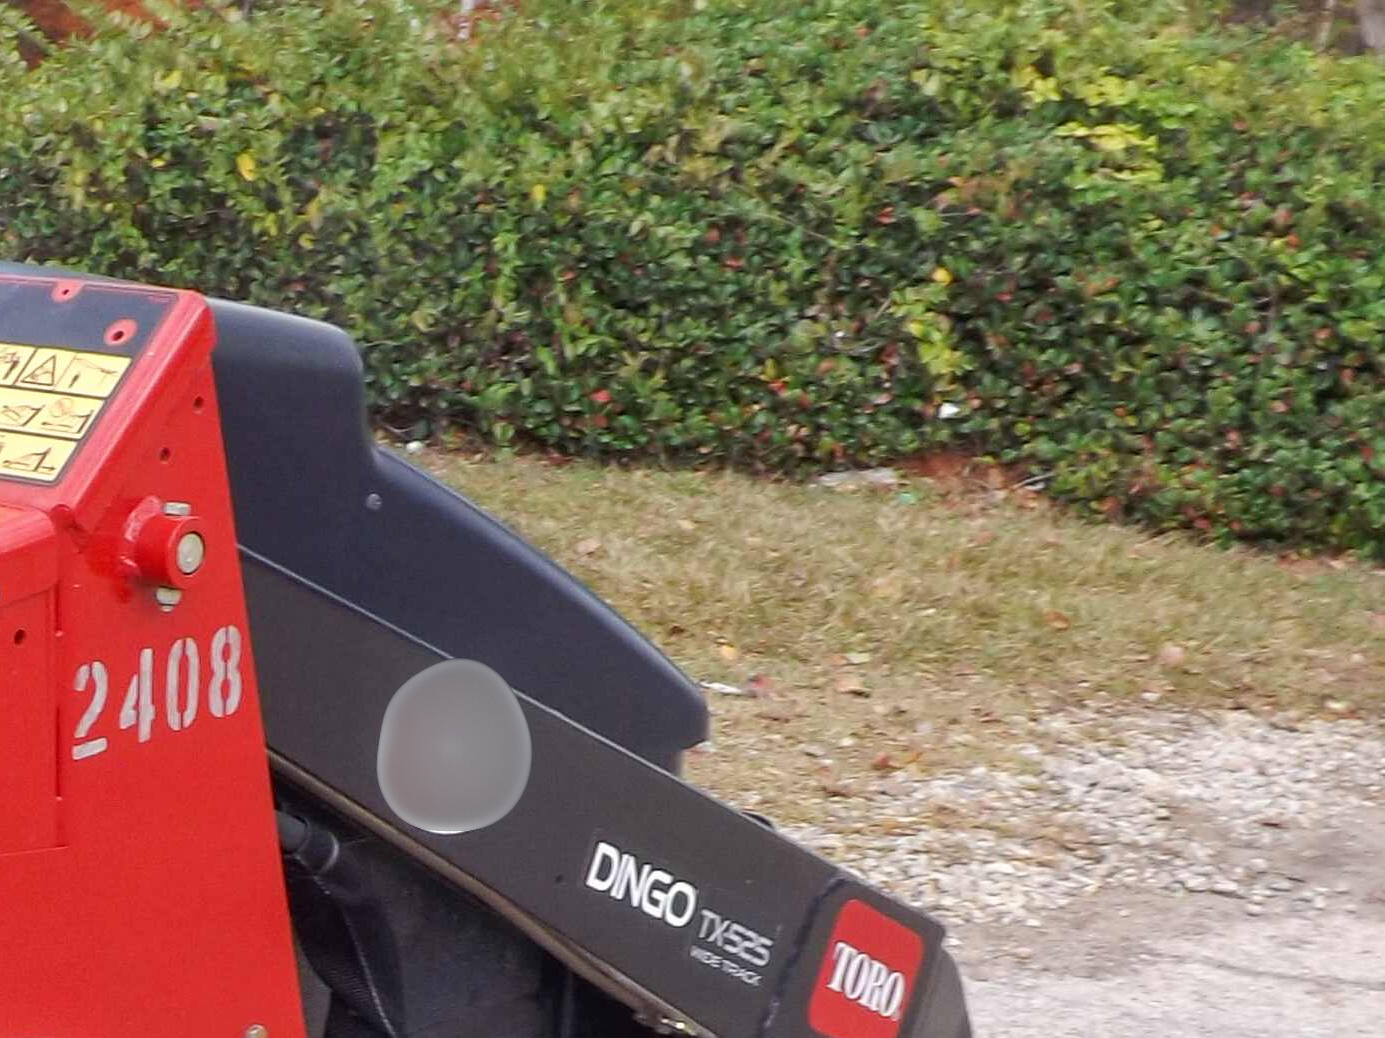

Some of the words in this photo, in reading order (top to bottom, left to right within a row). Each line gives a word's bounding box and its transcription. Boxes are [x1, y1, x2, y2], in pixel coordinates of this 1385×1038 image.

[71, 625, 242, 760] 2408
[585, 841, 697, 927] DINGO
[825, 941, 905, 1017] TORO
